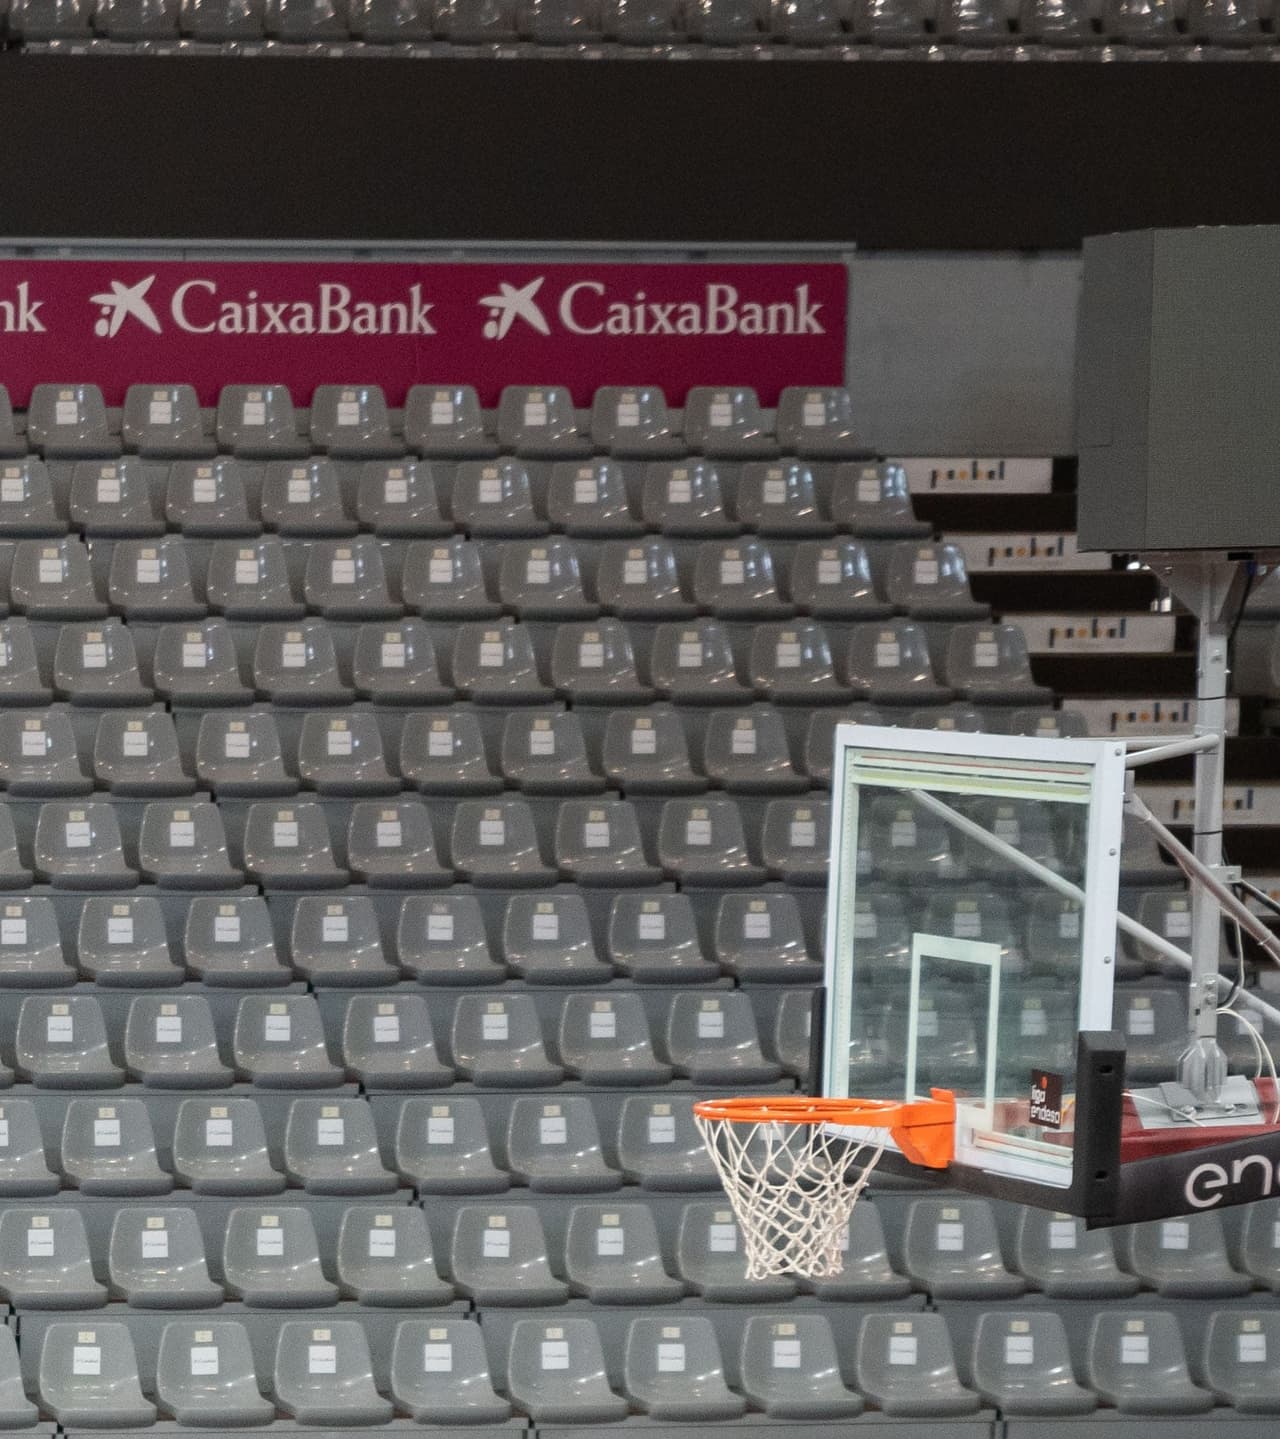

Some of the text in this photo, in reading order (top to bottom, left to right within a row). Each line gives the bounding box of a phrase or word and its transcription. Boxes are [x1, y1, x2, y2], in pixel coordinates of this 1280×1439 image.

[171, 279, 436, 335] CaixaBank
[559, 281, 825, 336] CaixaBank
[1185, 1153, 1280, 1209] en
